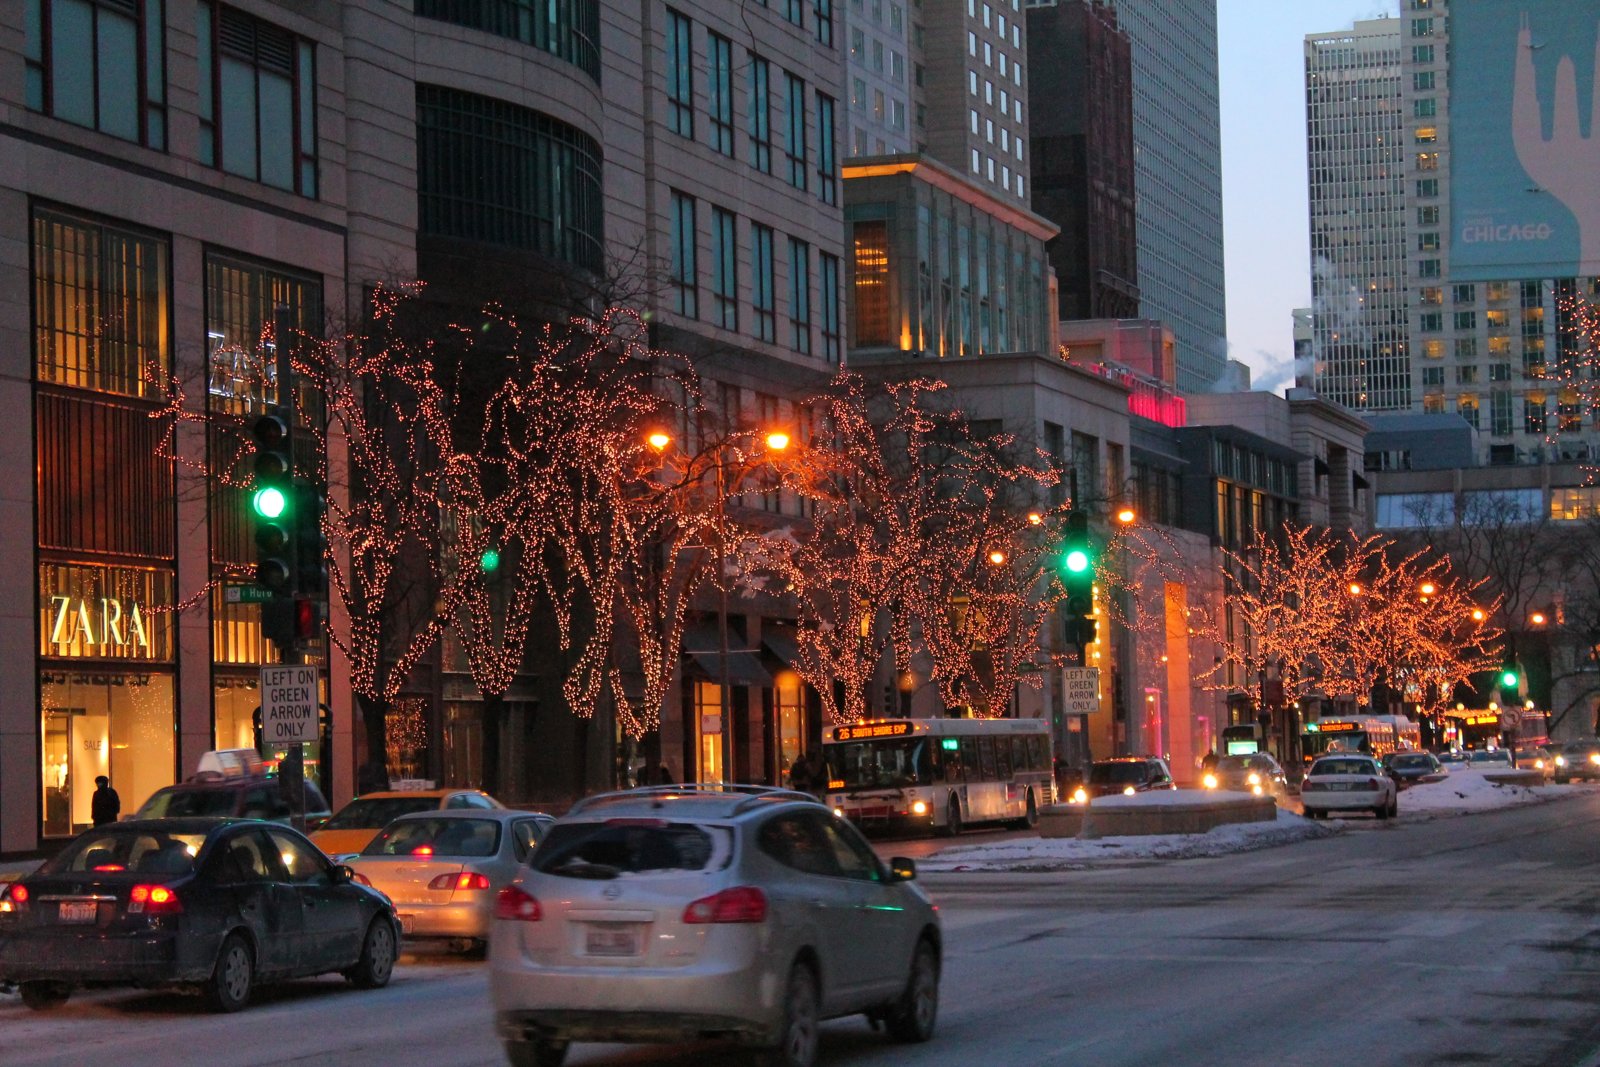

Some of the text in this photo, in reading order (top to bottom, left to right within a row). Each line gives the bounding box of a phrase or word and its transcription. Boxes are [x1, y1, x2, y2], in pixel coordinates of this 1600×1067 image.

[1461, 223, 1553, 244] CHICAGO
[51, 596, 148, 647] ZARA
[265, 670, 314, 686] LEFT ON
[1065, 670, 1097, 680] LEFT ON
[1069, 680, 1094, 690] GREEN
[271, 688, 309, 703] GREEN
[1069, 690, 1095, 700] ARROW
[270, 705, 311, 719] ARROW
[1072, 701, 1091, 711] ONLY
[276, 723, 305, 737] ONLY
[839, 724, 907, 740] 26 SOUTH SHORE EXP
[83, 740, 102, 751] SALE
